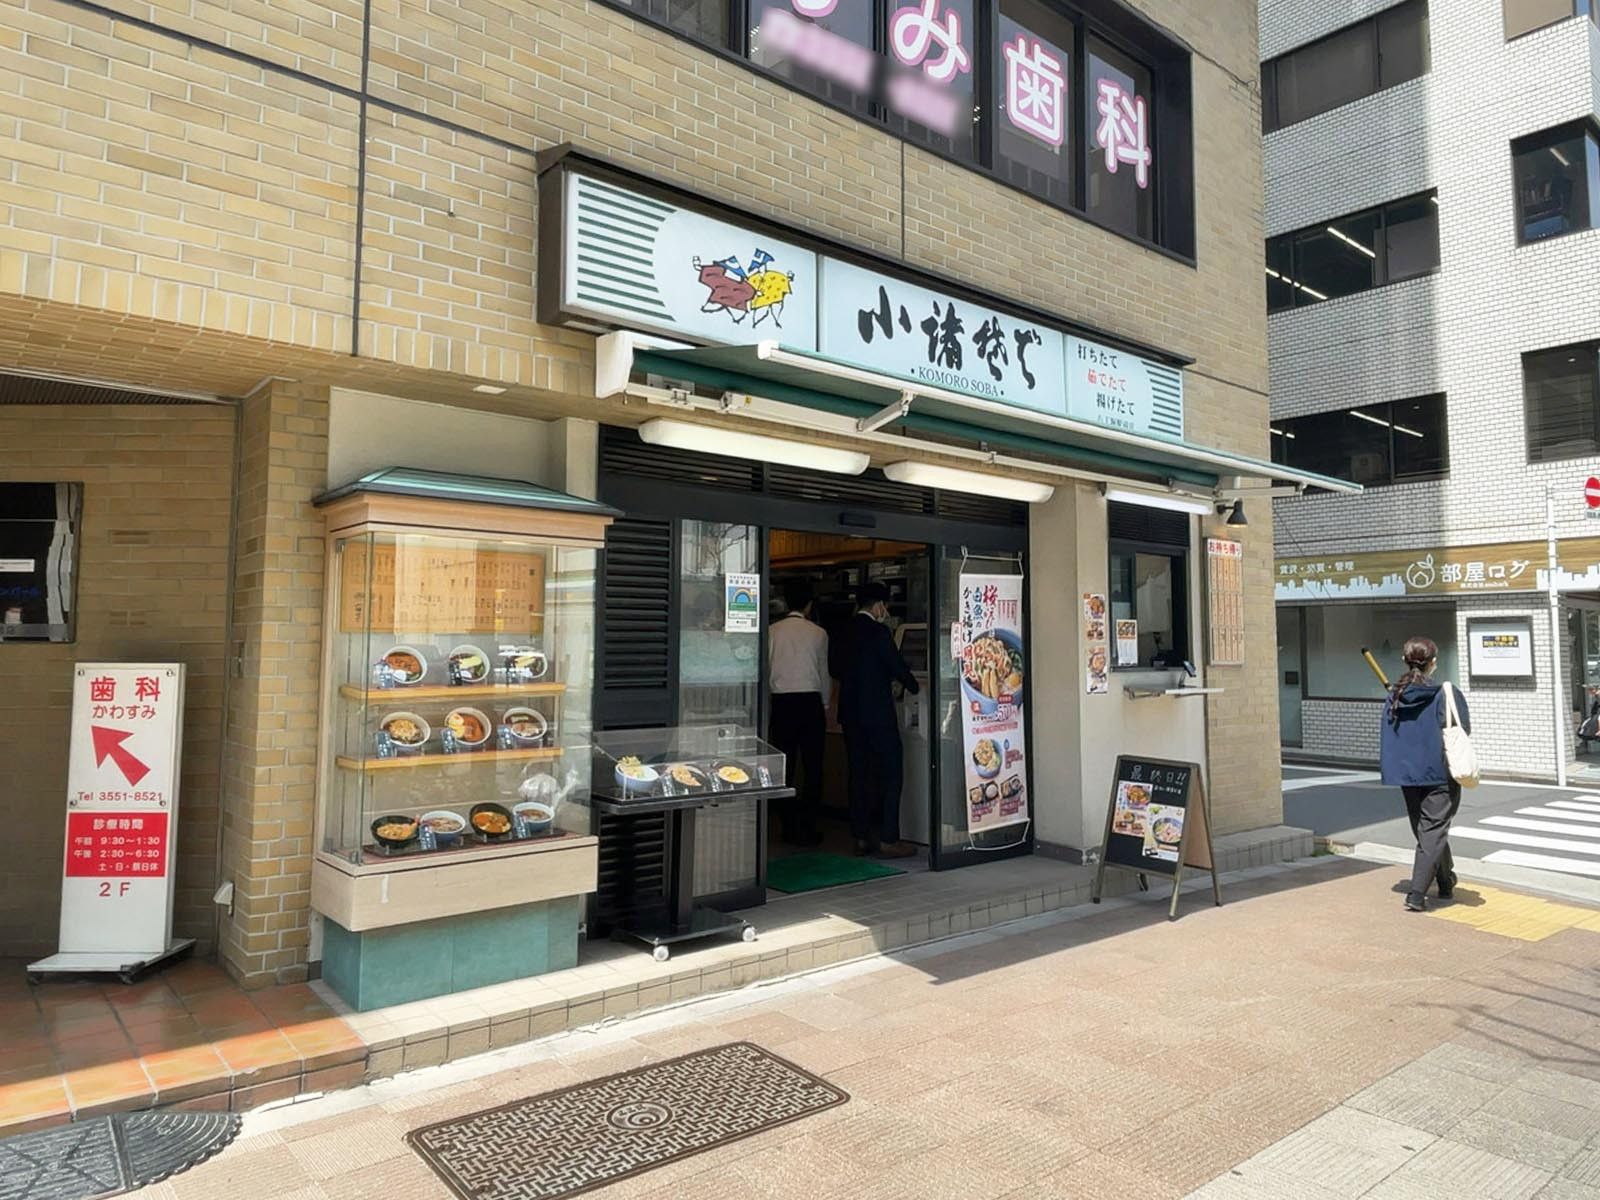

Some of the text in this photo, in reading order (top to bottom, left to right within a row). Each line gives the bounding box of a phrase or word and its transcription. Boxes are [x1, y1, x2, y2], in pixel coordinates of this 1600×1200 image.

[1078, 344, 1117, 369] 打ちたて
[918, 367, 999, 397] KOMORO SOBA
[1097, 392, 1134, 416] 揚げたて
[1441, 560, 1530, 583] 部屋ログ
[90, 677, 161, 702] 歯科
[92, 704, 157, 720] かわすみ
[78, 791, 163, 802] Tel 3551-8521
[93, 819, 144, 831] 診療時間
[99, 882, 131, 897] 2F
